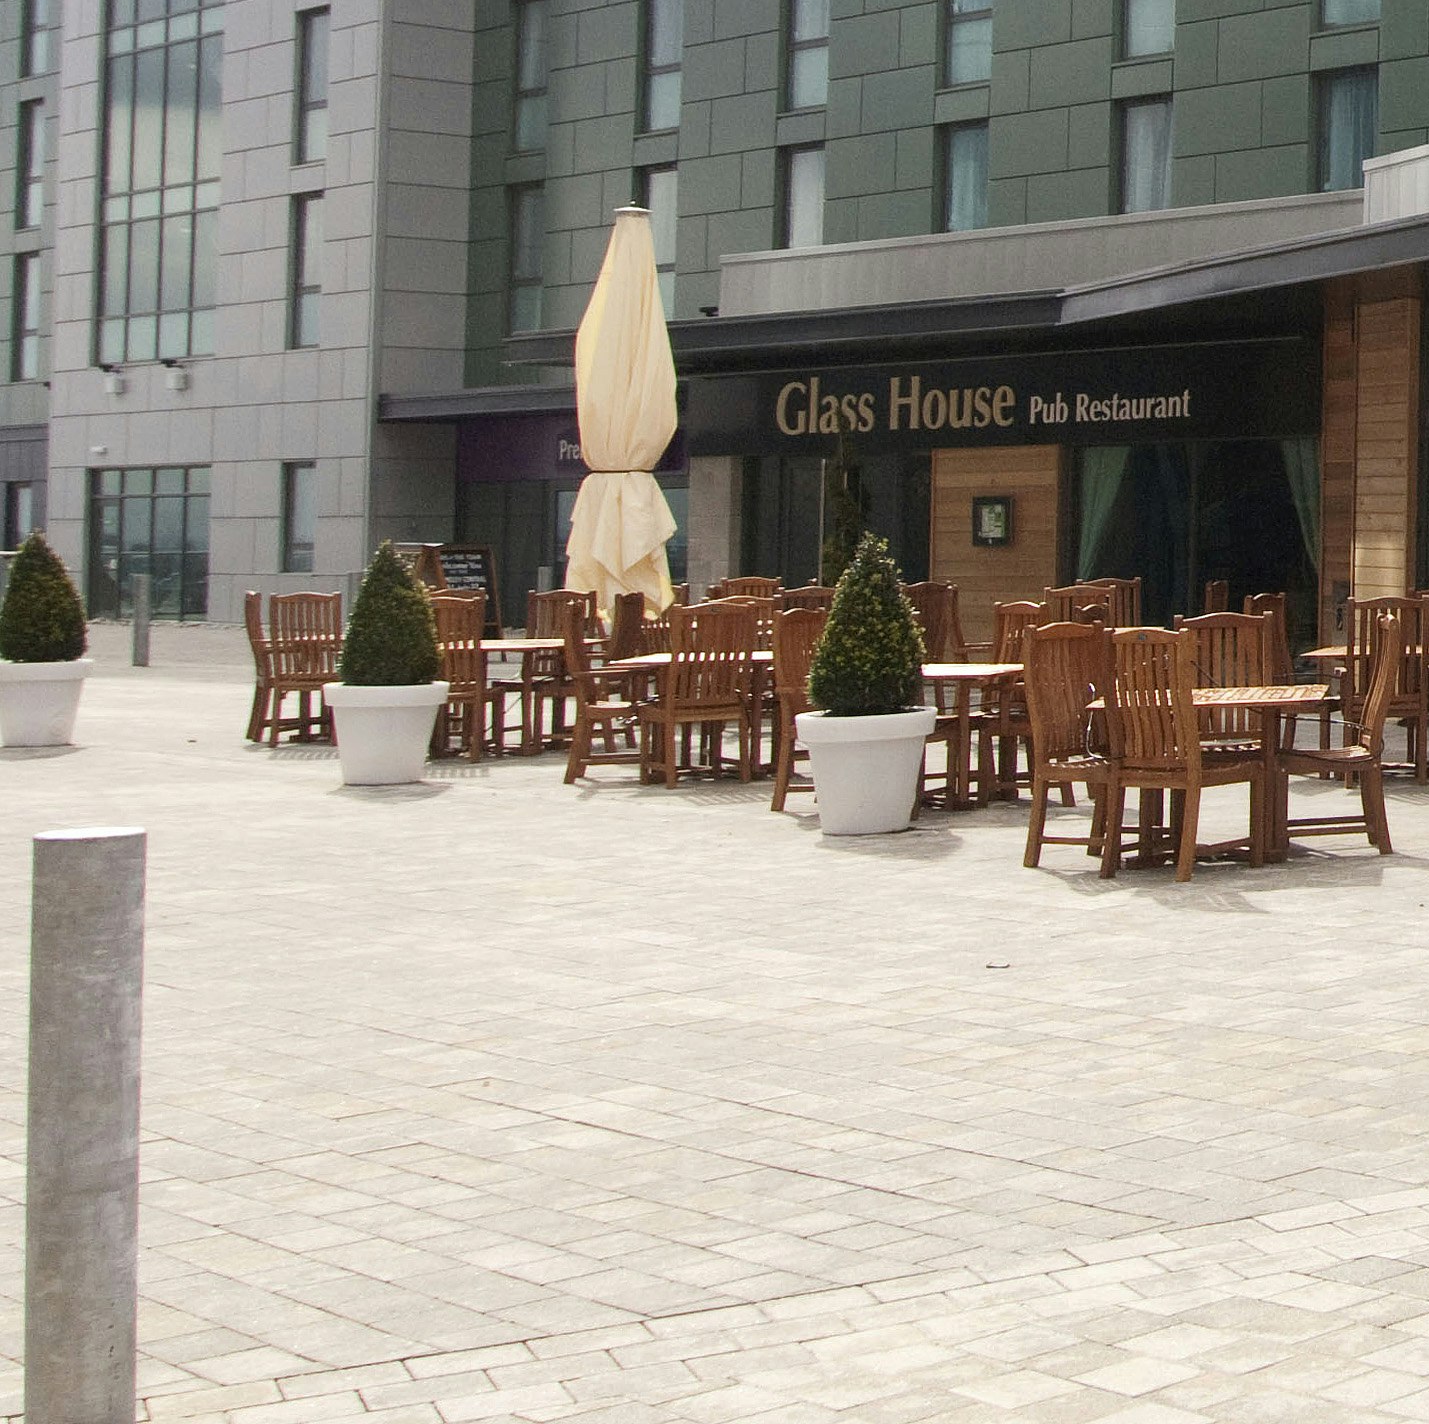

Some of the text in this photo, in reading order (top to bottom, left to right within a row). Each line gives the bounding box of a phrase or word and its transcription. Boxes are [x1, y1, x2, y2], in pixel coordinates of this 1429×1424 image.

[775, 375, 1191, 436] Glass House Pub Restaurant
[559, 439, 583, 460] Pre
